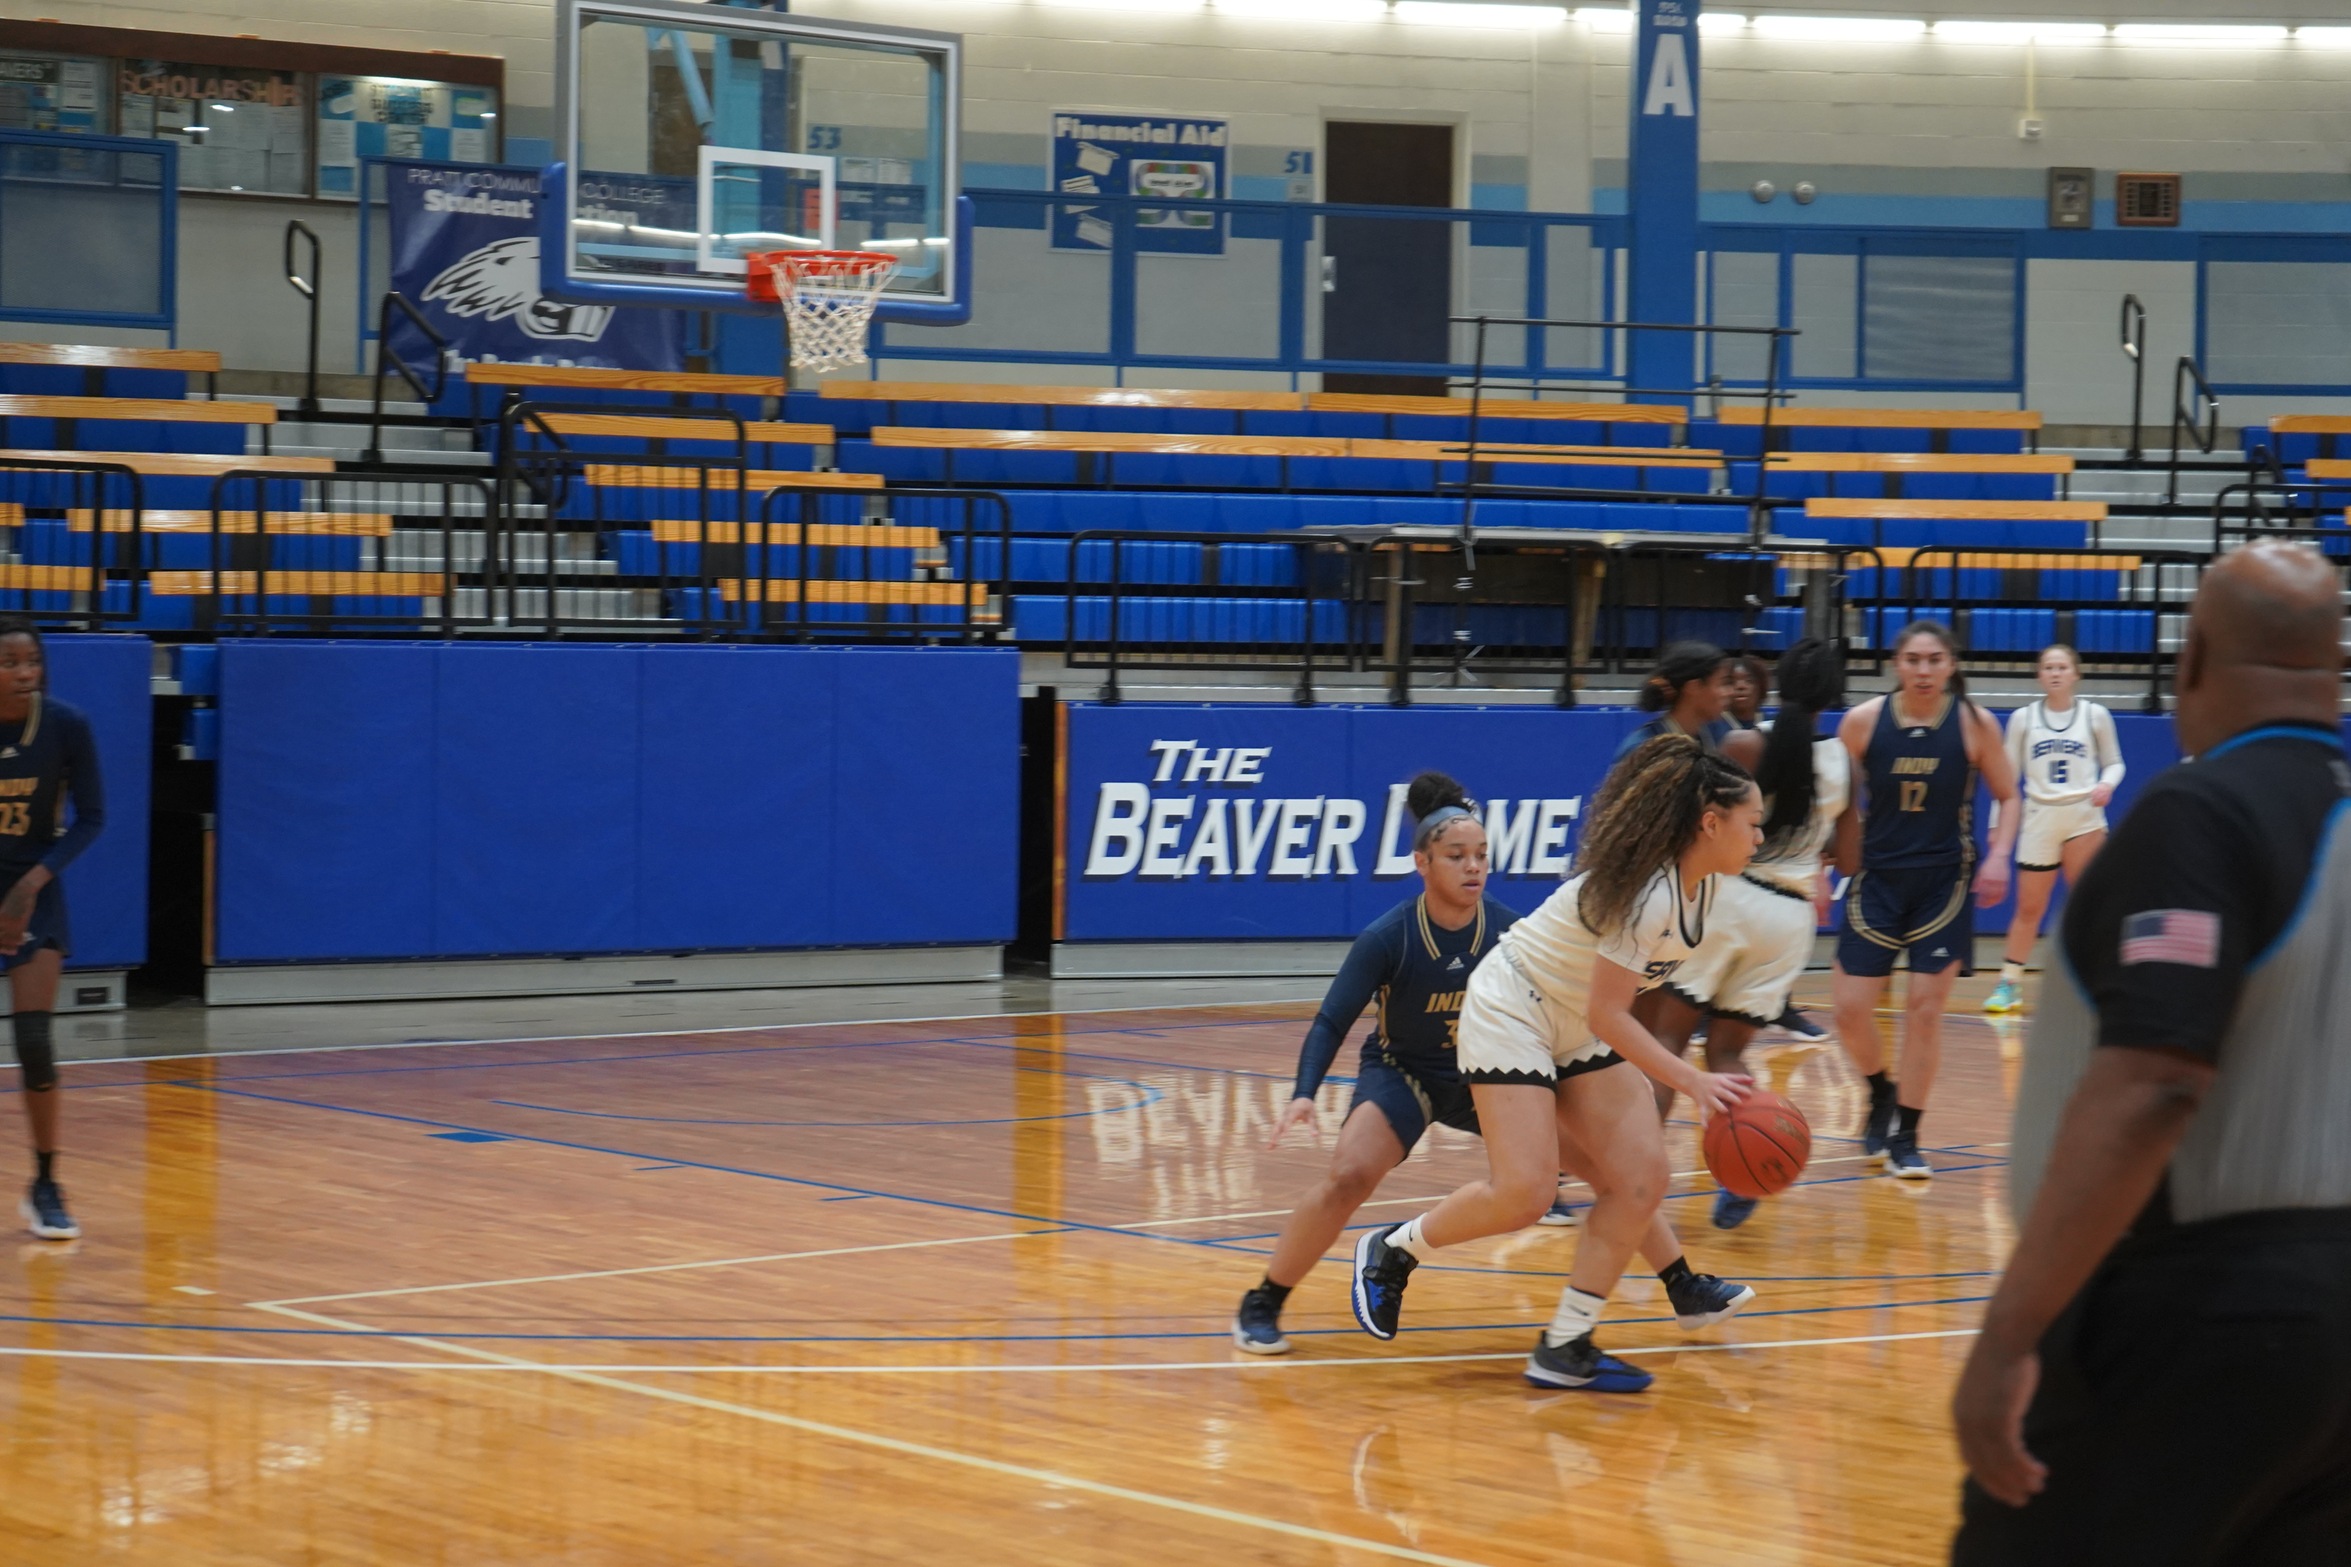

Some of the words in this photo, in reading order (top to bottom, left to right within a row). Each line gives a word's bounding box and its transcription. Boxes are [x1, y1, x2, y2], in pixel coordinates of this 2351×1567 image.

[1642, 33, 1695, 117] A
[808, 126, 842, 150] 53
[1055, 116, 1177, 144] Financial
[1178, 124, 1227, 147] Aid
[1284, 151, 1313, 174] 51
[423, 188, 534, 219] Student
[1150, 739, 1273, 783] THE
[1899, 780, 1929, 812] 12
[1084, 782, 1366, 878] BEAVER
[1373, 783, 1582, 875] DME
[1425, 990, 1468, 1013] IND
